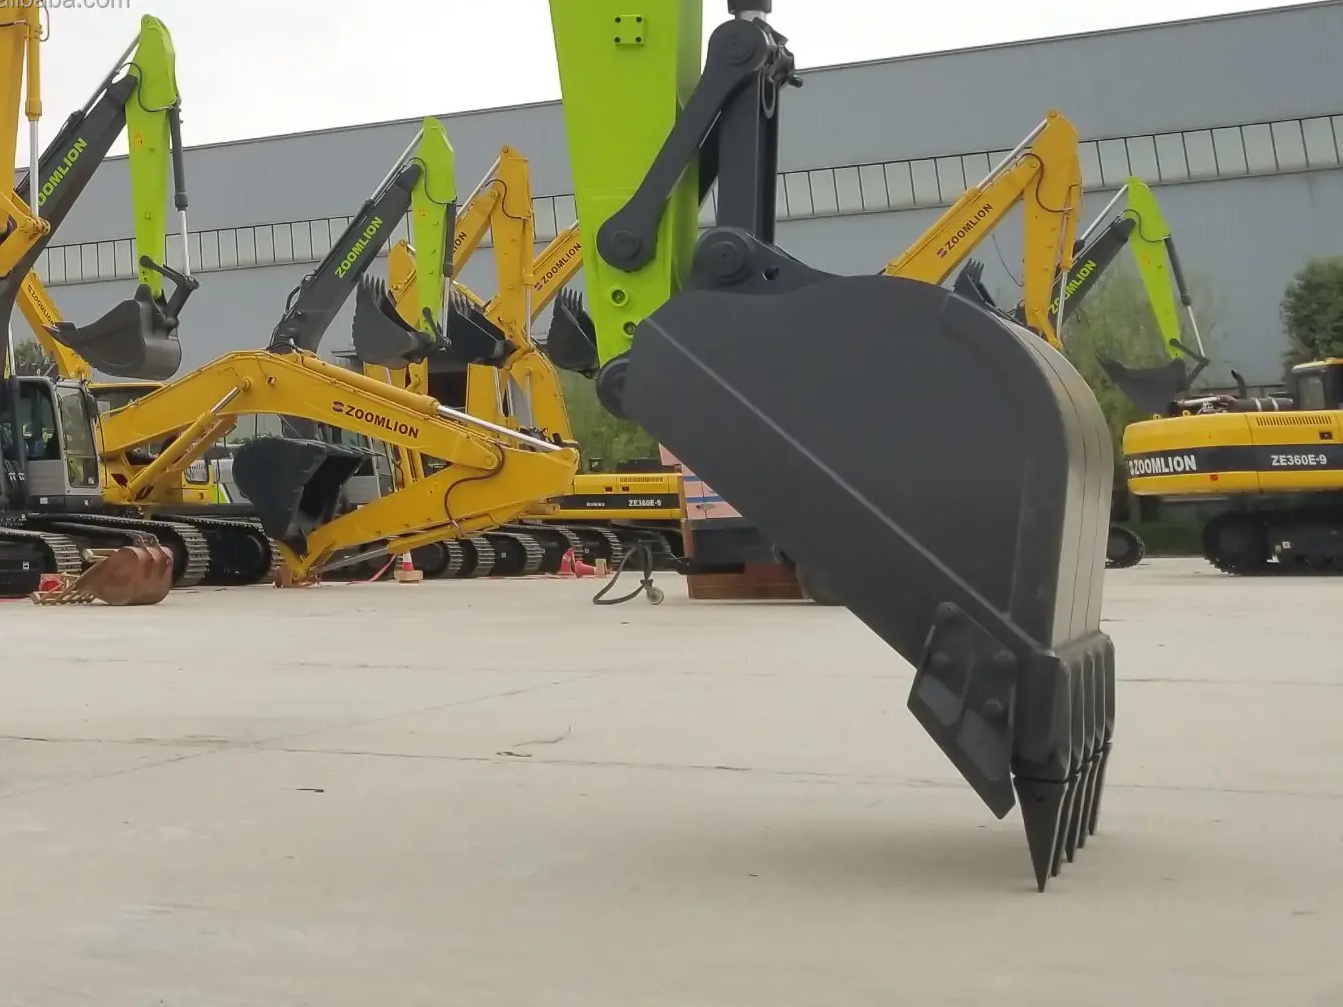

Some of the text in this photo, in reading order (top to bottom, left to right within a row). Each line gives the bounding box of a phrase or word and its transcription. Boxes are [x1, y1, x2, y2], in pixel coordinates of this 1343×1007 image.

[38, 137, 88, 206] OOMLION
[946, 203, 994, 250] ZOOMLION
[334, 216, 383, 279] ZOOMLION
[542, 243, 582, 284] ZOOMLION
[345, 405, 420, 439] ZOOMLION
[1133, 454, 1197, 475] ZOOMLION
[1270, 454, 1328, 466] ZE360E-9
